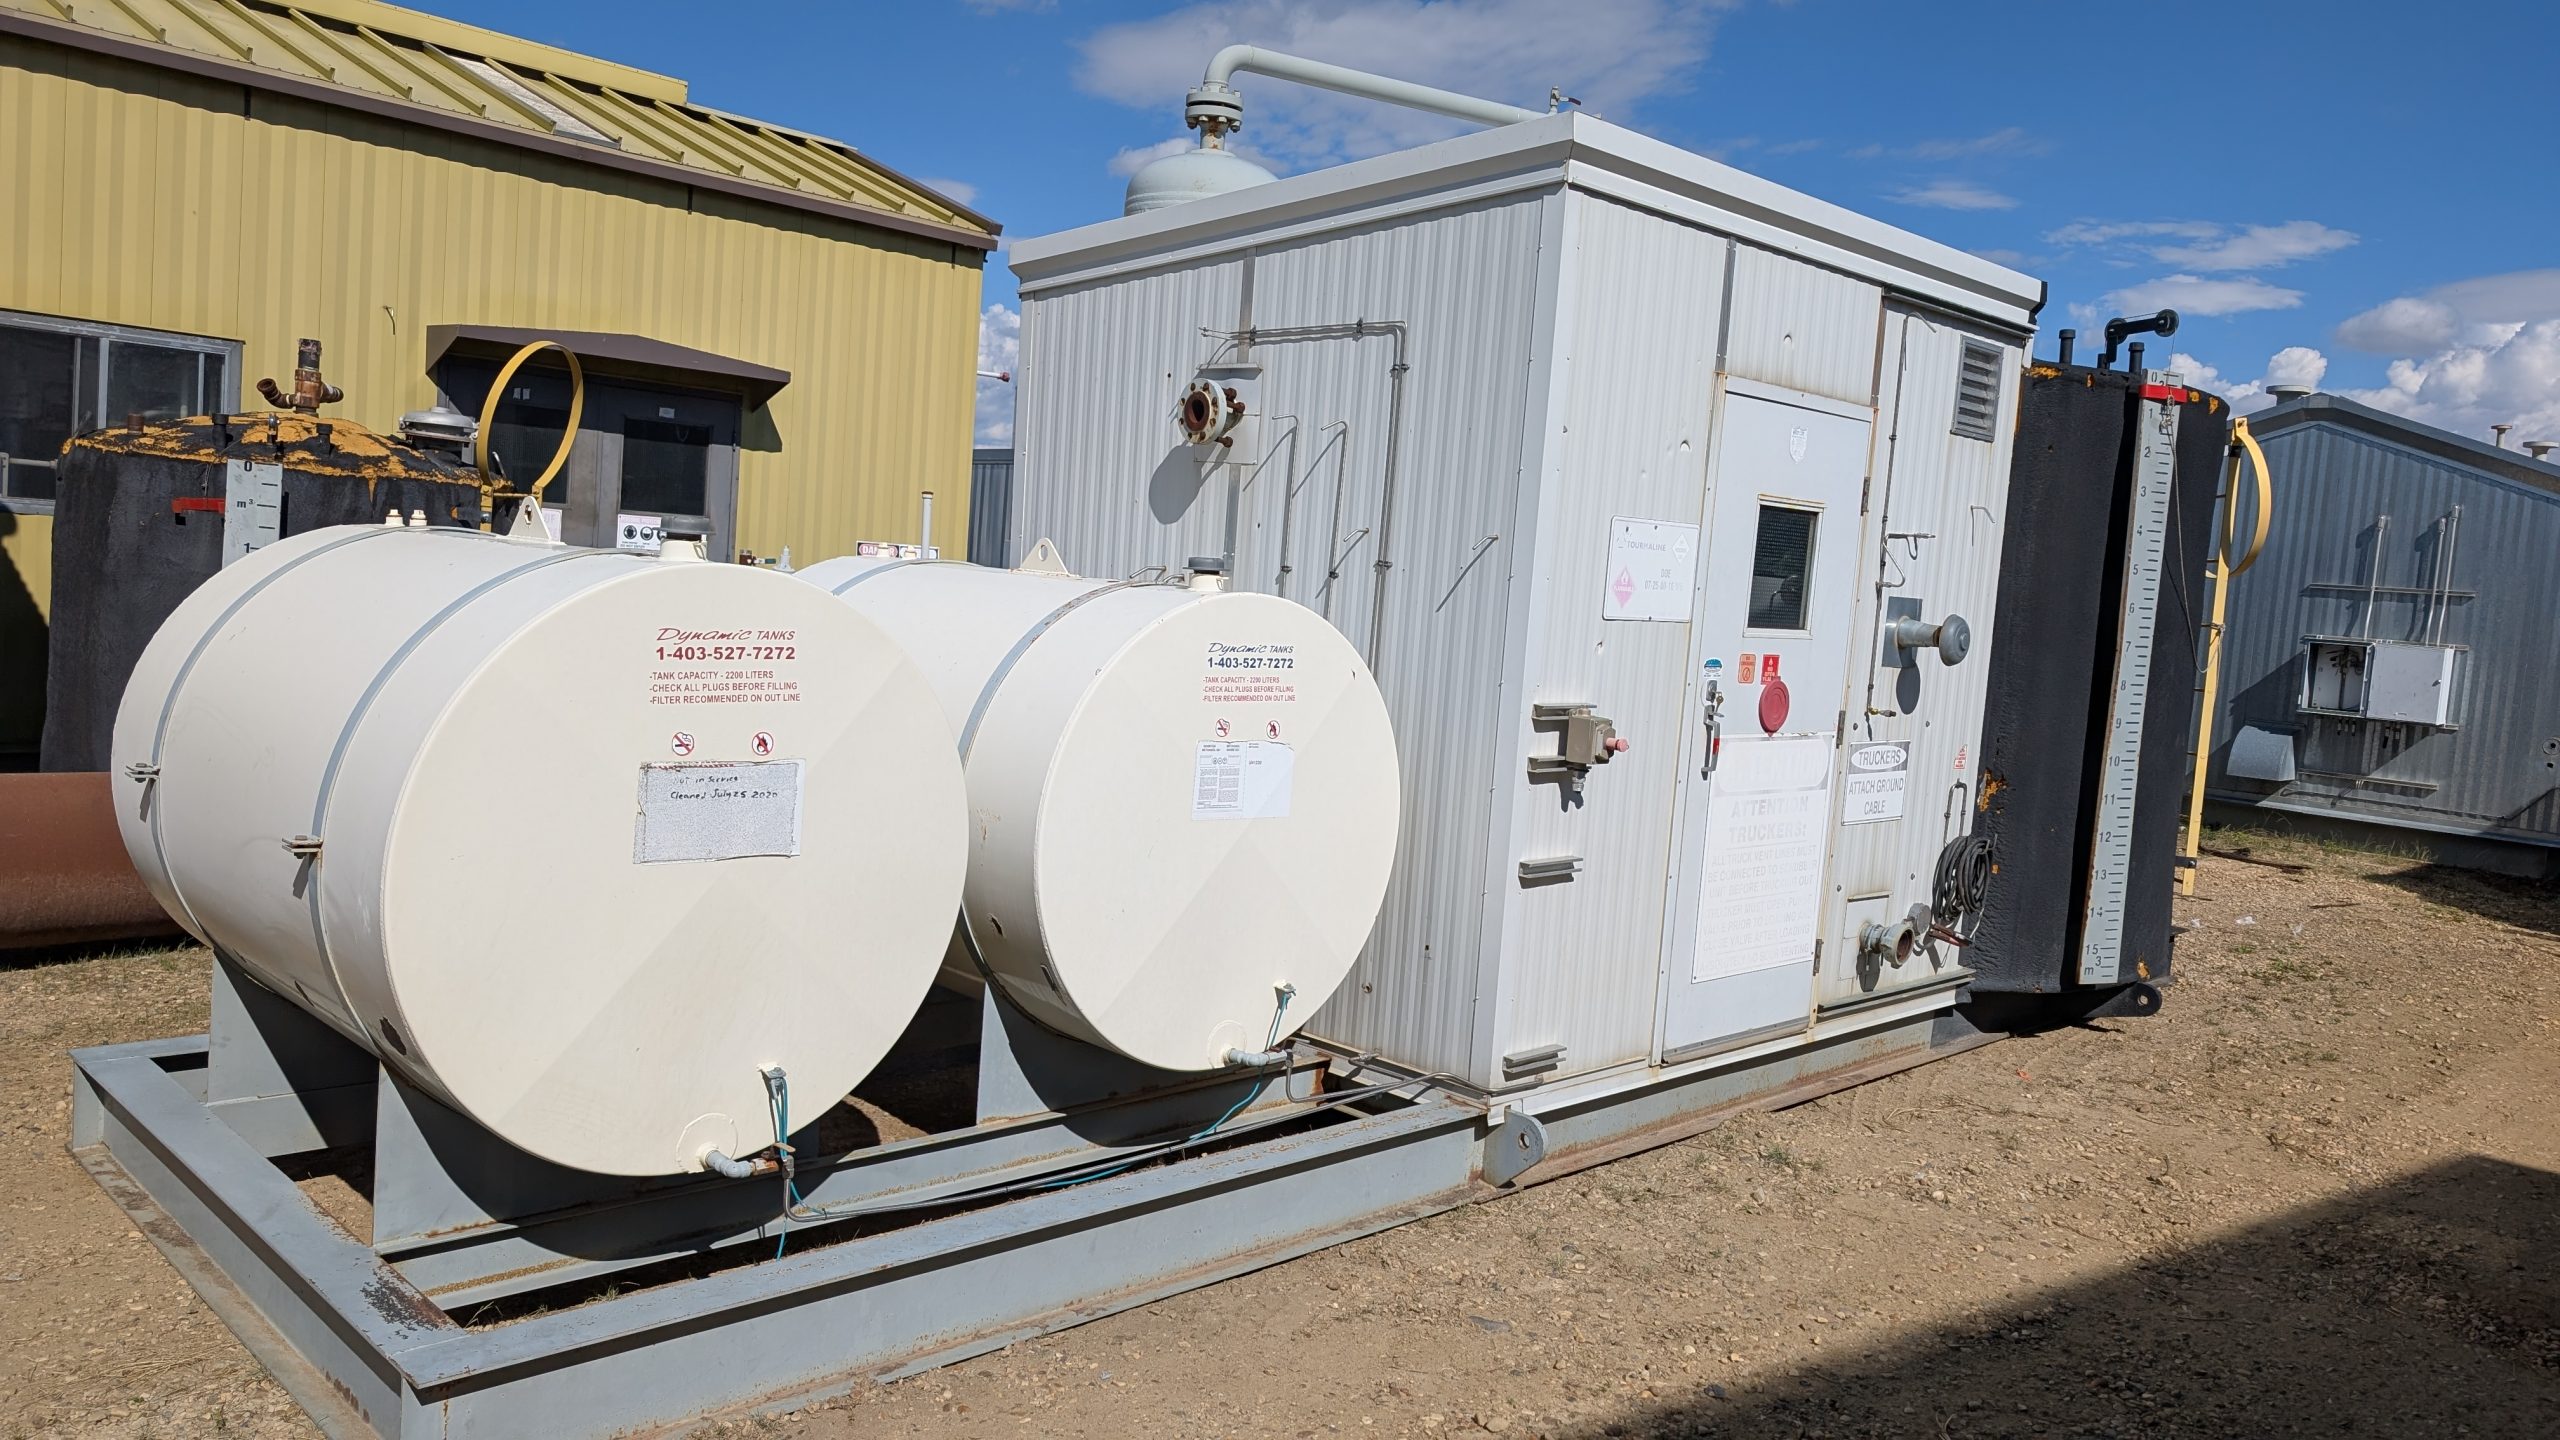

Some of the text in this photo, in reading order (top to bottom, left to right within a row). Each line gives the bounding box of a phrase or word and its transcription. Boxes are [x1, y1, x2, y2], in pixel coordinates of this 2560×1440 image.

[2144, 446, 2151, 458] 2
[244, 461, 253, 472] 0
[2140, 486, 2147, 498] 3
[2136, 525, 2143, 537] 4
[244, 542, 251, 553] 1
[2132, 565, 2139, 576] 5
[2129, 602, 2135, 614] 6
[656, 627, 796, 645] Dynamic TANKS
[1208, 642, 1294, 657] Dynamic TANKS
[2125, 641, 2132, 652] 7
[656, 646, 796, 661] 1-403-527-7272
[1207, 657, 1294, 669] 1-403-527-7272
[677, 671, 719, 680] CAPACITY
[725, 671, 744, 679] 2200
[745, 670, 774, 679] LITERS
[1220, 676, 1246, 684] CAPACITY
[1262, 676, 1280, 684] LITERS
[684, 683, 700, 692] ALL
[702, 683, 730, 692] PLUGS
[732, 682, 766, 691] BEFORE
[767, 681, 798, 691] FILLING
[2120, 680, 2127, 691] 8
[683, 694, 749, 704] RECOMMENDED
[750, 694, 763, 703] ON
[764, 693, 782, 703] OUT
[783, 693, 801, 702] LINE
[2115, 718, 2122, 729] 9
[1859, 749, 1901, 766] TRUCKERS
[2108, 756, 2120, 767] 10
[1848, 777, 1904, 795] ATTACH GROUND
[733, 790, 747, 798] 25
[751, 790, 778, 798] 2020
[2103, 794, 2115, 805] 11
[1731, 796, 1809, 818] ATTENTION
[1864, 800, 1887, 815] CABLE
[1729, 821, 1807, 843] TRUCKERS:
[2099, 832, 2111, 843] 12
[2094, 869, 2107, 880] 13
[2089, 907, 2103, 918] 14
[2085, 944, 2098, 955] 15
